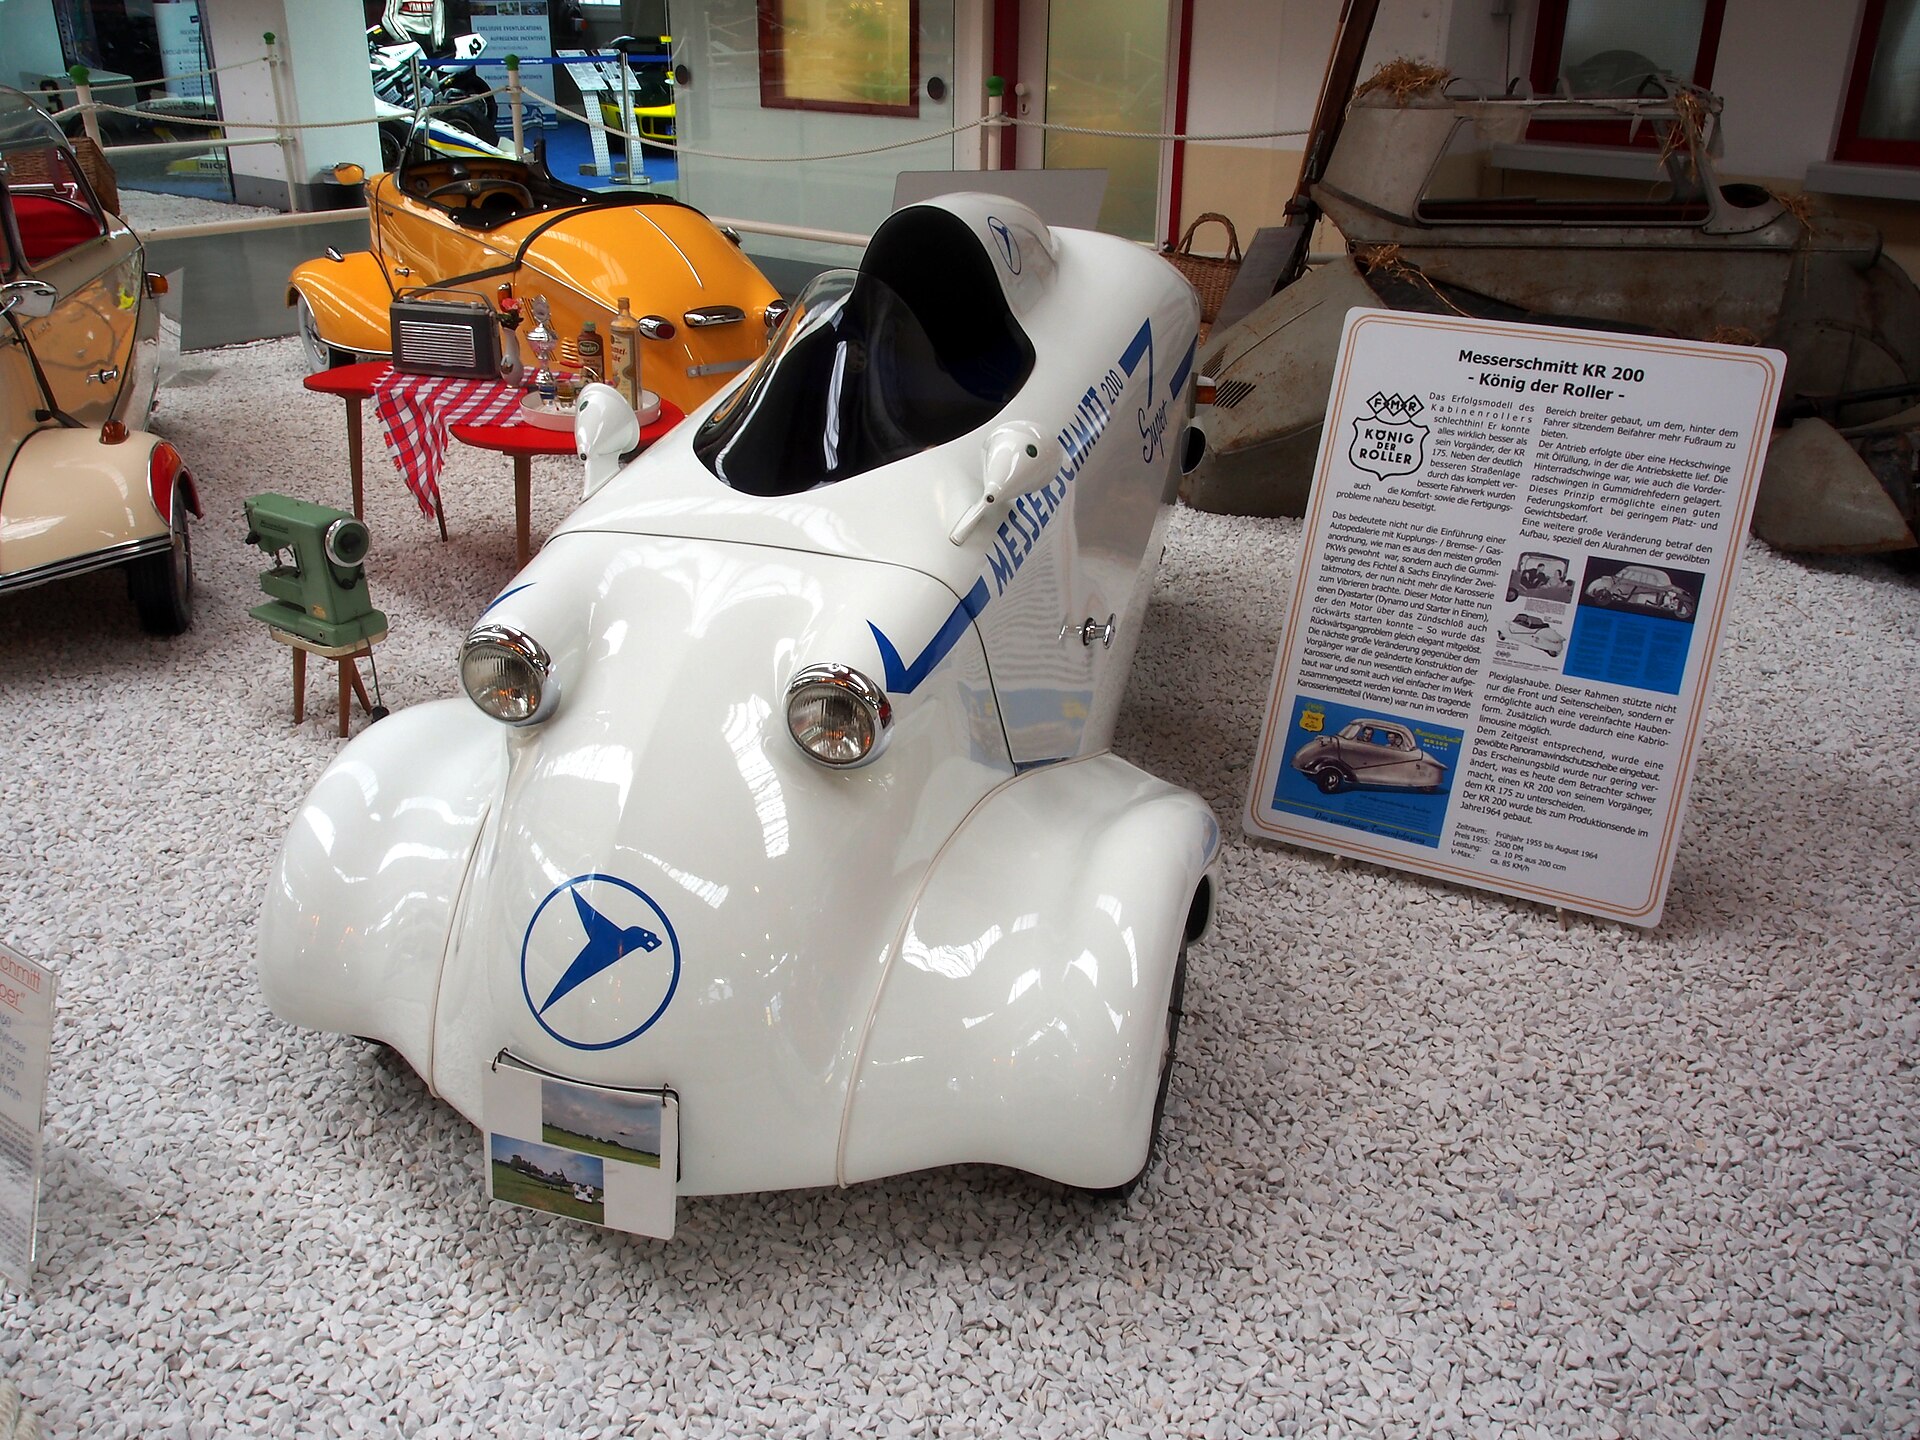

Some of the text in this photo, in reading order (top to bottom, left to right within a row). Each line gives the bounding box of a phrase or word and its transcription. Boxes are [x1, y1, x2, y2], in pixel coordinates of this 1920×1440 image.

[1458, 349, 1644, 382] Messerschmitt KR 200
[1100, 369, 1123, 405] 200
[1478, 372, 1525, 392] König
[1530, 378, 1559, 393] der
[1562, 382, 1614, 400] Roller
[1429, 391, 1445, 401] Das
[1518, 403, 1534, 412] des
[1138, 399, 1168, 464] Super
[1487, 421, 1496, 429] Er
[1500, 423, 1530, 434] konnte
[1545, 406, 1576, 417] Bereich
[1579, 410, 1608, 421] breiter
[1689, 423, 1716, 434] hinter
[1718, 428, 1738, 437] dem
[1364, 428, 1414, 444] KÖNIG
[1376, 441, 1396, 451] DER
[1434, 438, 1451, 446] sein
[1497, 446, 1511, 454] der
[1513, 448, 1525, 456] KR
[1437, 427, 1527, 445] alles wirklich besser als
[1359, 447, 1411, 464] ROLLER
[1429, 458, 1520, 478] besseren Straßenlage
[1450, 450, 1475, 461] Neben
[1476, 454, 1490, 462] der
[1491, 456, 1522, 467] deutlich
[1538, 439, 1730, 472] Der Antrieb erfolgte über eine Heckschwinge
[1416, 479, 1515, 500] besserte Fahrwerk wurden
[1427, 470, 1449, 479] durch
[1450, 473, 1464, 482] das
[1466, 475, 1500, 487] komplett
[1335, 491, 1371, 502] probleme
[1372, 496, 1400, 506] nahezu
[1353, 482, 1371, 490] auch
[1387, 486, 1399, 494] die
[1433, 494, 1455, 503] sowie
[1456, 496, 1469, 505] die
[1528, 484, 1720, 518] Dieses Prinzip ermöglichte einen guten
[1521, 517, 1712, 553] Eine weitere große Veränderung betraf den
[1325, 542, 1346, 552] PKWs
[1347, 547, 1380, 558] gewohnt
[1401, 556, 1432, 566] sondern
[1433, 561, 1452, 569] auch
[1454, 563, 1466, 572] die
[1312, 606, 1350, 618] rückwärts
[1354, 614, 1382, 624] starten
[1385, 618, 1413, 630] konnte
[1426, 625, 1437, 634] So
[1441, 630, 1466, 640] wurde
[1470, 634, 1485, 643] das
[1314, 595, 1487, 632] der den Motor über das Zündschloß auch
[1554, 683, 1581, 695] Dieser
[1584, 689, 1619, 702] Rahmen
[1622, 697, 1652, 708] stützte
[1654, 703, 1676, 713] nicht
[1476, 725, 1496, 735] Dem
[1500, 730, 1538, 745] Zeitgeist
[1611, 754, 1639, 765] wurde
[1644, 760, 1663, 770] eine
[1464, 779, 1482, 789] dem
[1484, 784, 1495, 793] KR
[1498, 787, 1513, 796] 175
[1514, 791, 1524, 799] zu
[1497, 776, 1520, 786] einen
[1522, 780, 1534, 789] KR
[1537, 783, 1553, 793] 200
[1556, 789, 1571, 797] von
[1574, 792, 1604, 804] seinem
